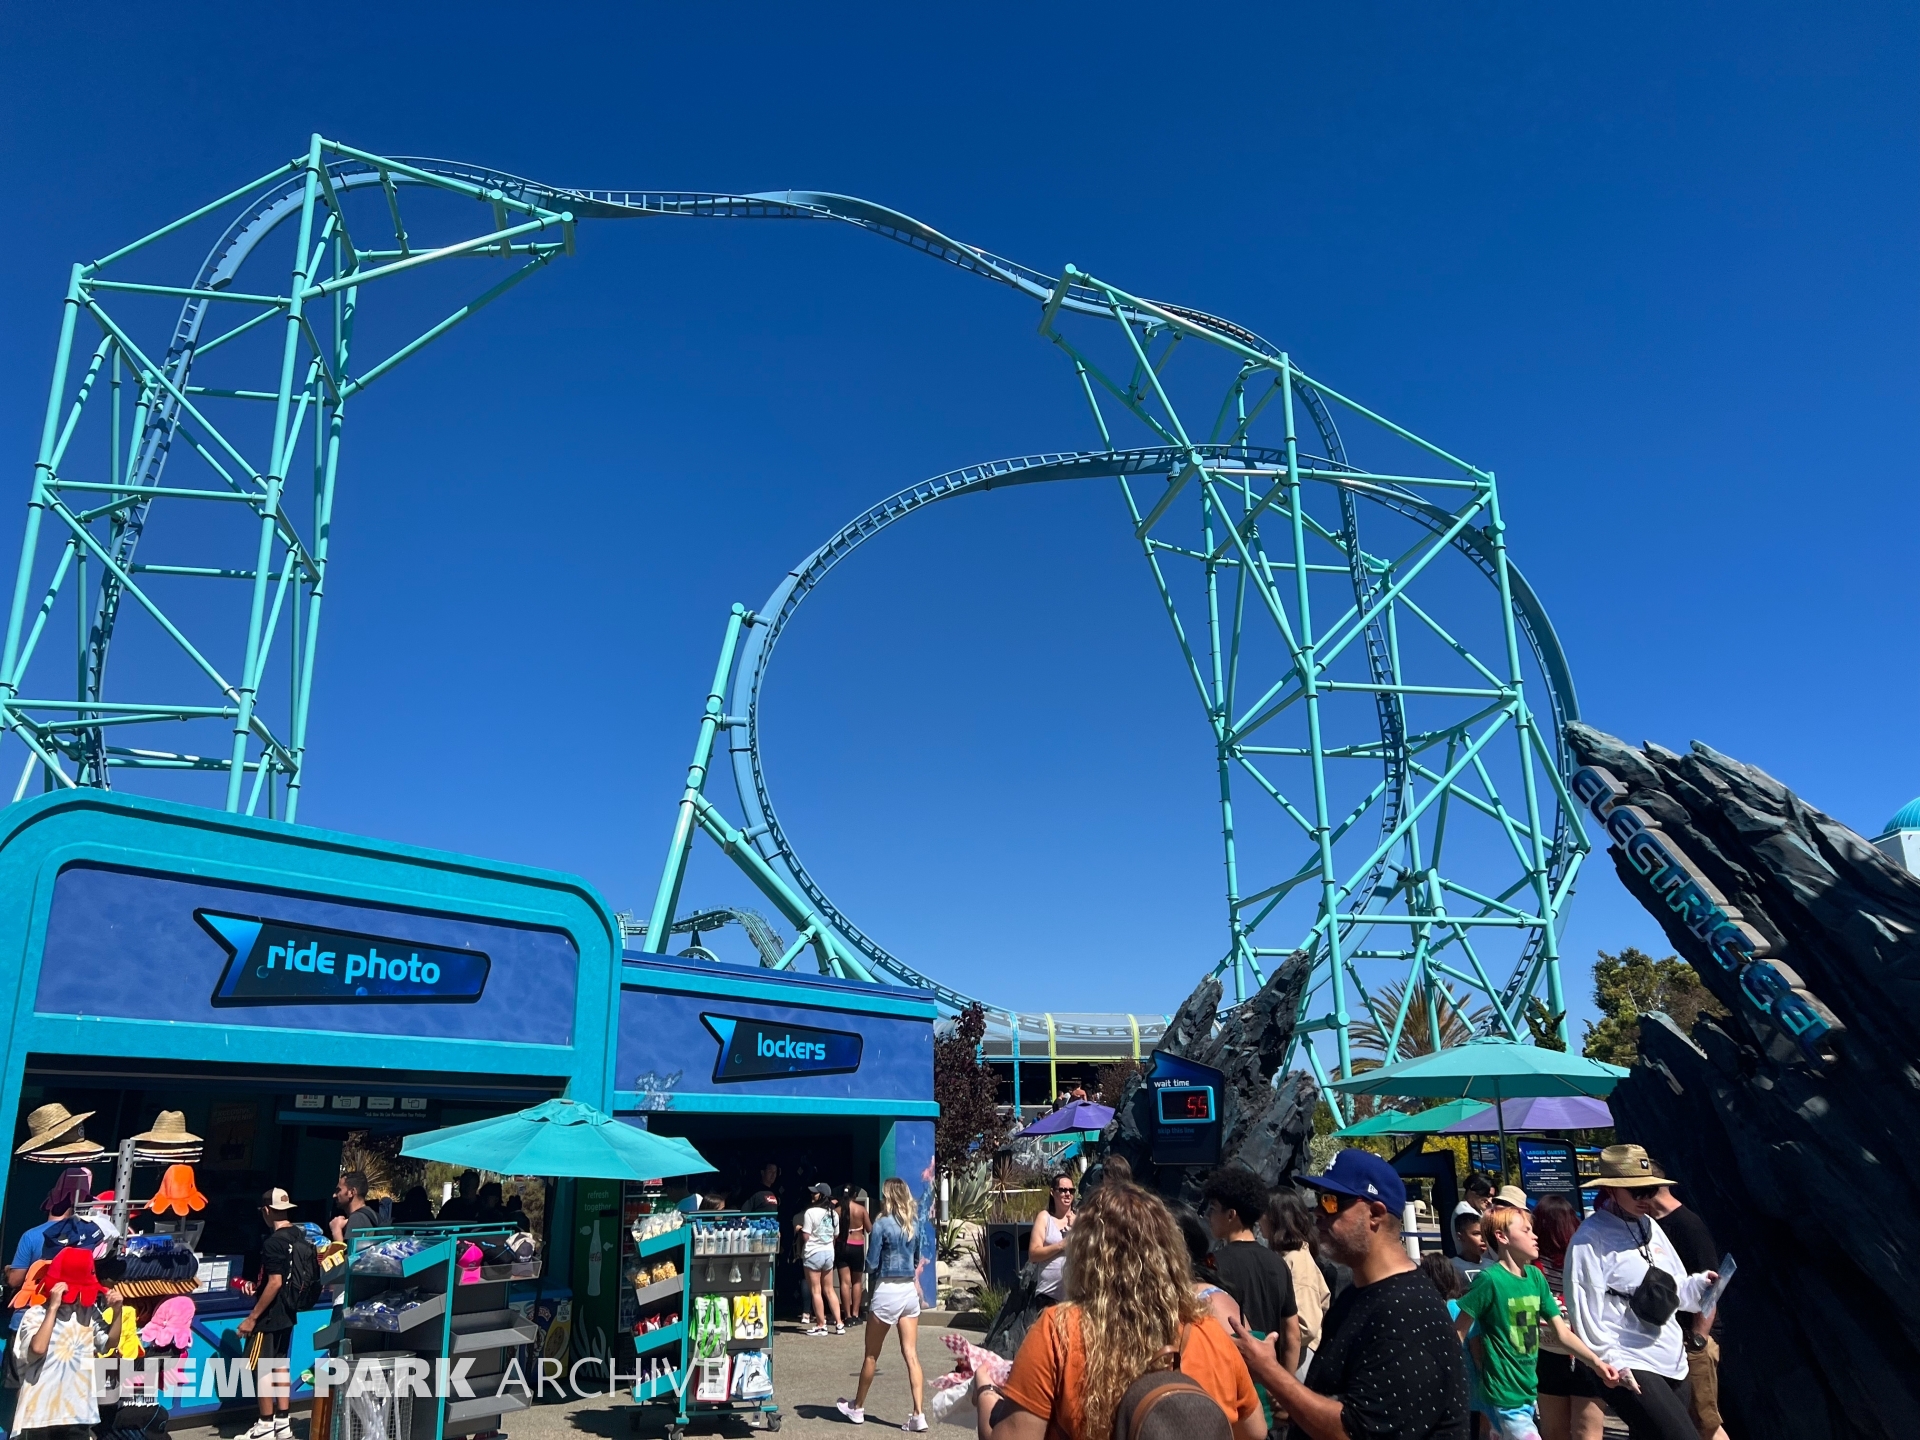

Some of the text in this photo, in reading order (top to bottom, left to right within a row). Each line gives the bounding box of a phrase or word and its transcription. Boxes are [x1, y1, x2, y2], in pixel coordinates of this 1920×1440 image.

[1571, 765, 1757, 972] ELECTRIC
[266, 940, 441, 985] ride photo
[757, 1032, 826, 1060] lockers
[1173, 1079, 1190, 1087] time
[1187, 1096, 1207, 1117] 55
[1157, 1127, 1171, 1135] skip
[587, 1190, 609, 1199] refresh
[584, 1203, 611, 1212] together
